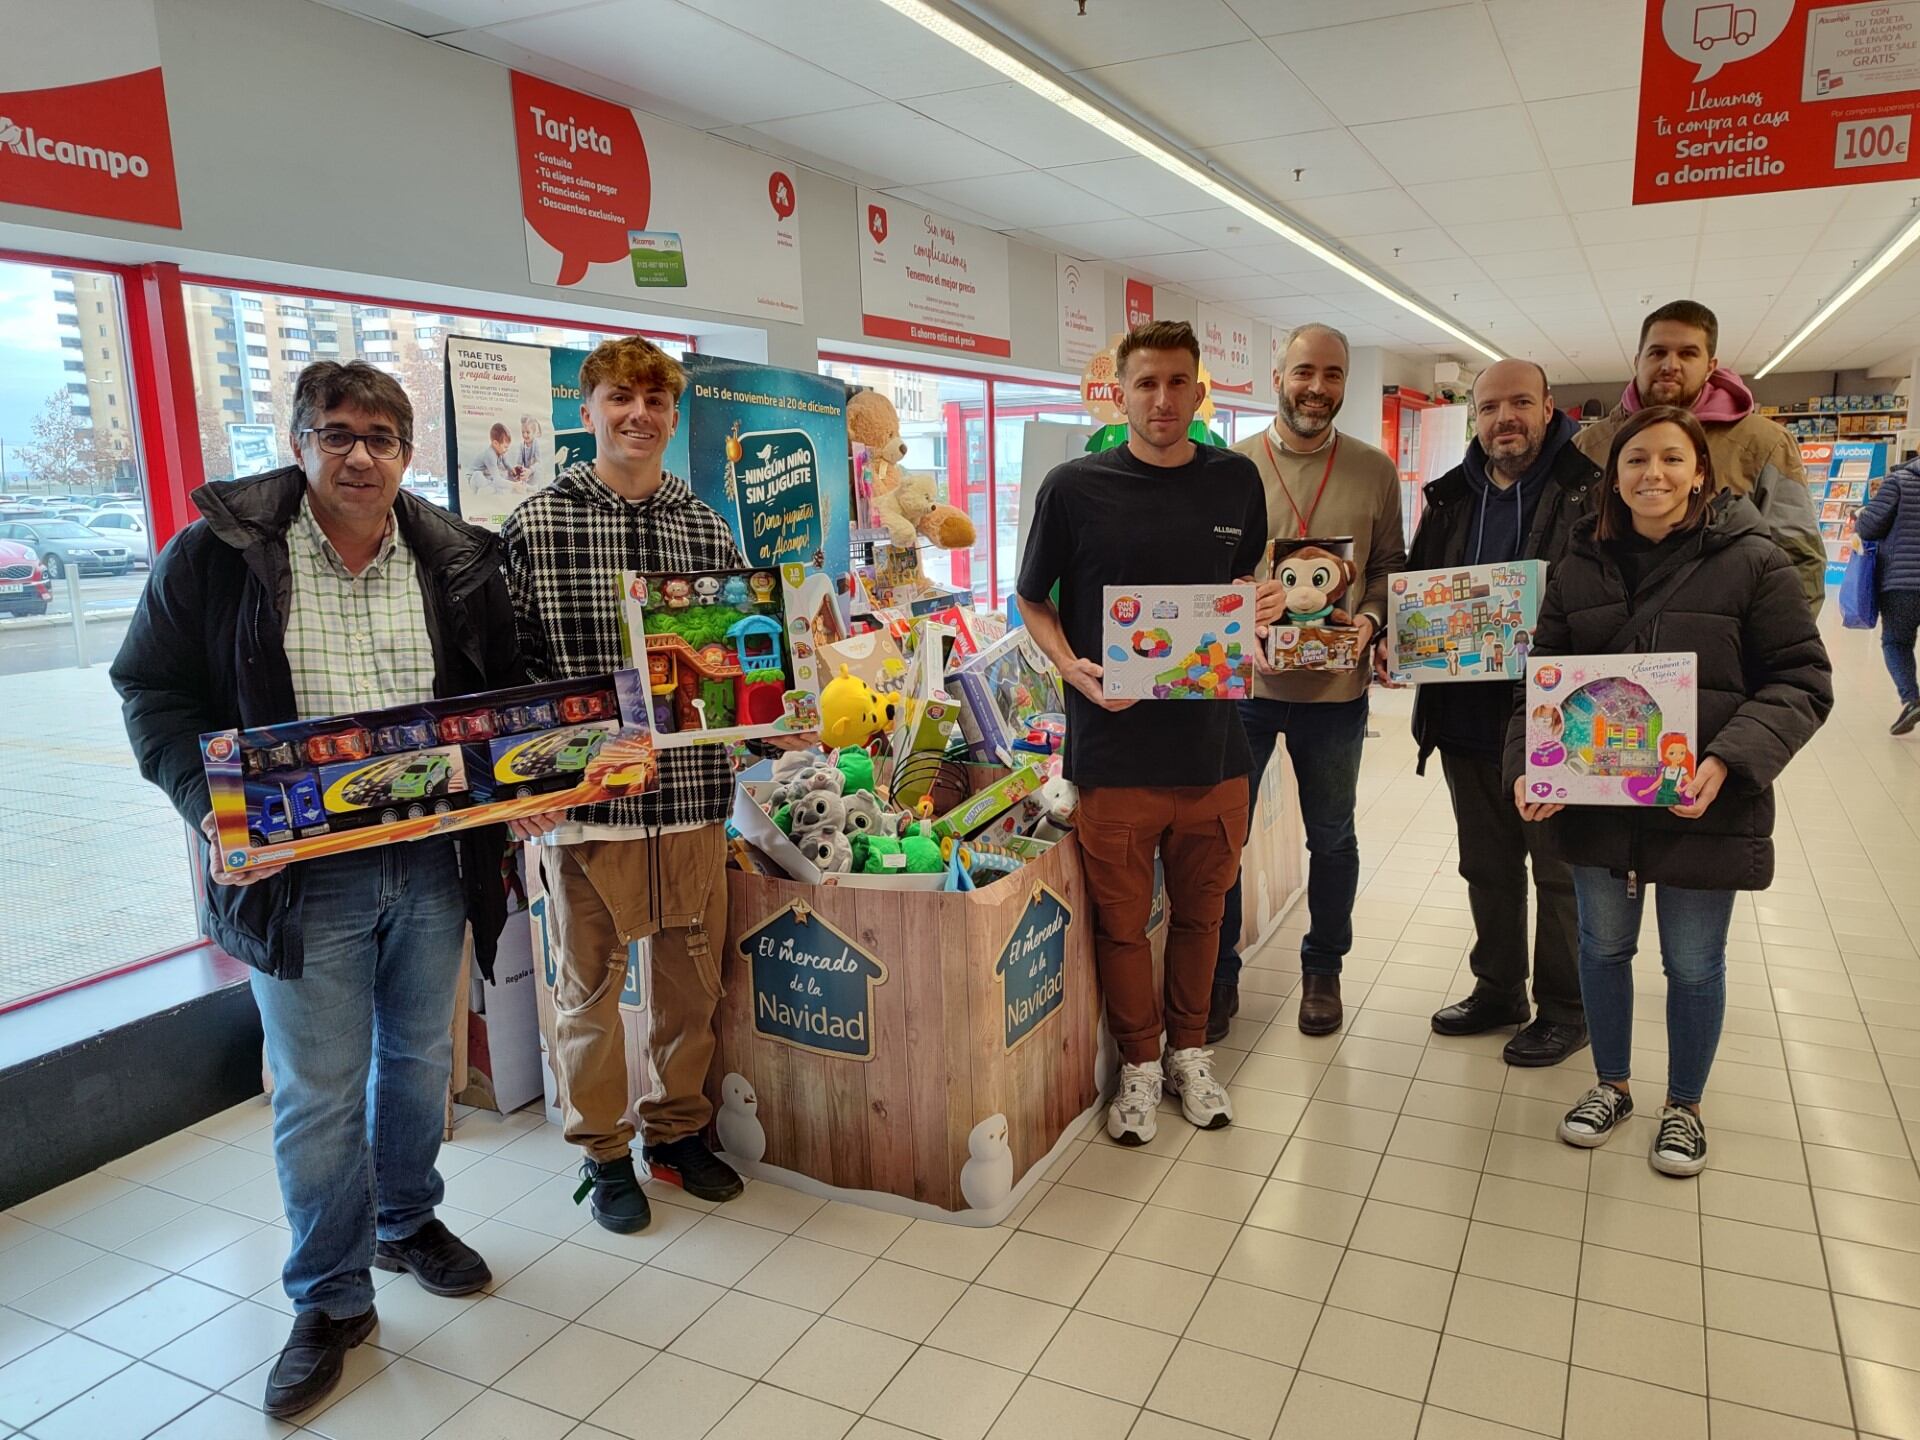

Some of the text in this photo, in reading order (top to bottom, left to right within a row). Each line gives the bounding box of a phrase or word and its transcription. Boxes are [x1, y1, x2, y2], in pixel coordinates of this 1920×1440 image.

[1869, 15, 1904, 26] TARJETA
[1871, 8, 1889, 16] CON
[1845, 23, 1912, 38] CLUB ALCAMPO
[1836, 46, 1881, 57] DOMICILIO
[1896, 41, 1918, 50] SALE
[1686, 88, 1763, 113] Llevamos
[1844, 107, 1877, 116] compras
[1878, 103, 1916, 112] superiores
[530, 105, 612, 156] Tarjeta
[1652, 110, 1790, 138] tu compra a casa
[1675, 131, 1768, 159] Servicio
[539, 152, 572, 170] Gratuita
[1655, 155, 1785, 186] a domicilio
[540, 167, 618, 196] Tú eliges cómo pagar
[541, 182, 590, 202] Financiación
[543, 197, 625, 225] Descuentos exclusivos
[913, 239, 967, 272] complicaciones
[905, 266, 976, 294] Tenemos el mejor precio
[910, 326, 917, 337] El
[917, 328, 936, 340] ahorro
[960, 336, 976, 347] precio
[458, 350, 503, 362] TRAE TUS
[459, 360, 507, 371] JUGUETES
[695, 385, 841, 416] Del 5 de noviembre al 20 de diciembre
[745, 447, 811, 484] NINGÚN NIÑO
[746, 467, 811, 505] SIN JUGUETE
[781, 503, 814, 535] juguetes
[760, 545, 770, 559] en
[1117, 600, 1135, 608] ONE
[1117, 606, 1135, 614] TWO
[1118, 611, 1135, 619] FUN
[1111, 683, 1121, 691] 3+
[1537, 783, 1548, 793] 3+
[231, 856, 245, 865] 3+
[1009, 908, 1064, 966] El mercado
[759, 936, 859, 974] El mercado
[1029, 951, 1047, 979] de la
[505, 970, 528, 985] Regala
[790, 974, 823, 997] de la
[1008, 963, 1064, 1032] Navidad
[758, 991, 865, 1041] Navidad
